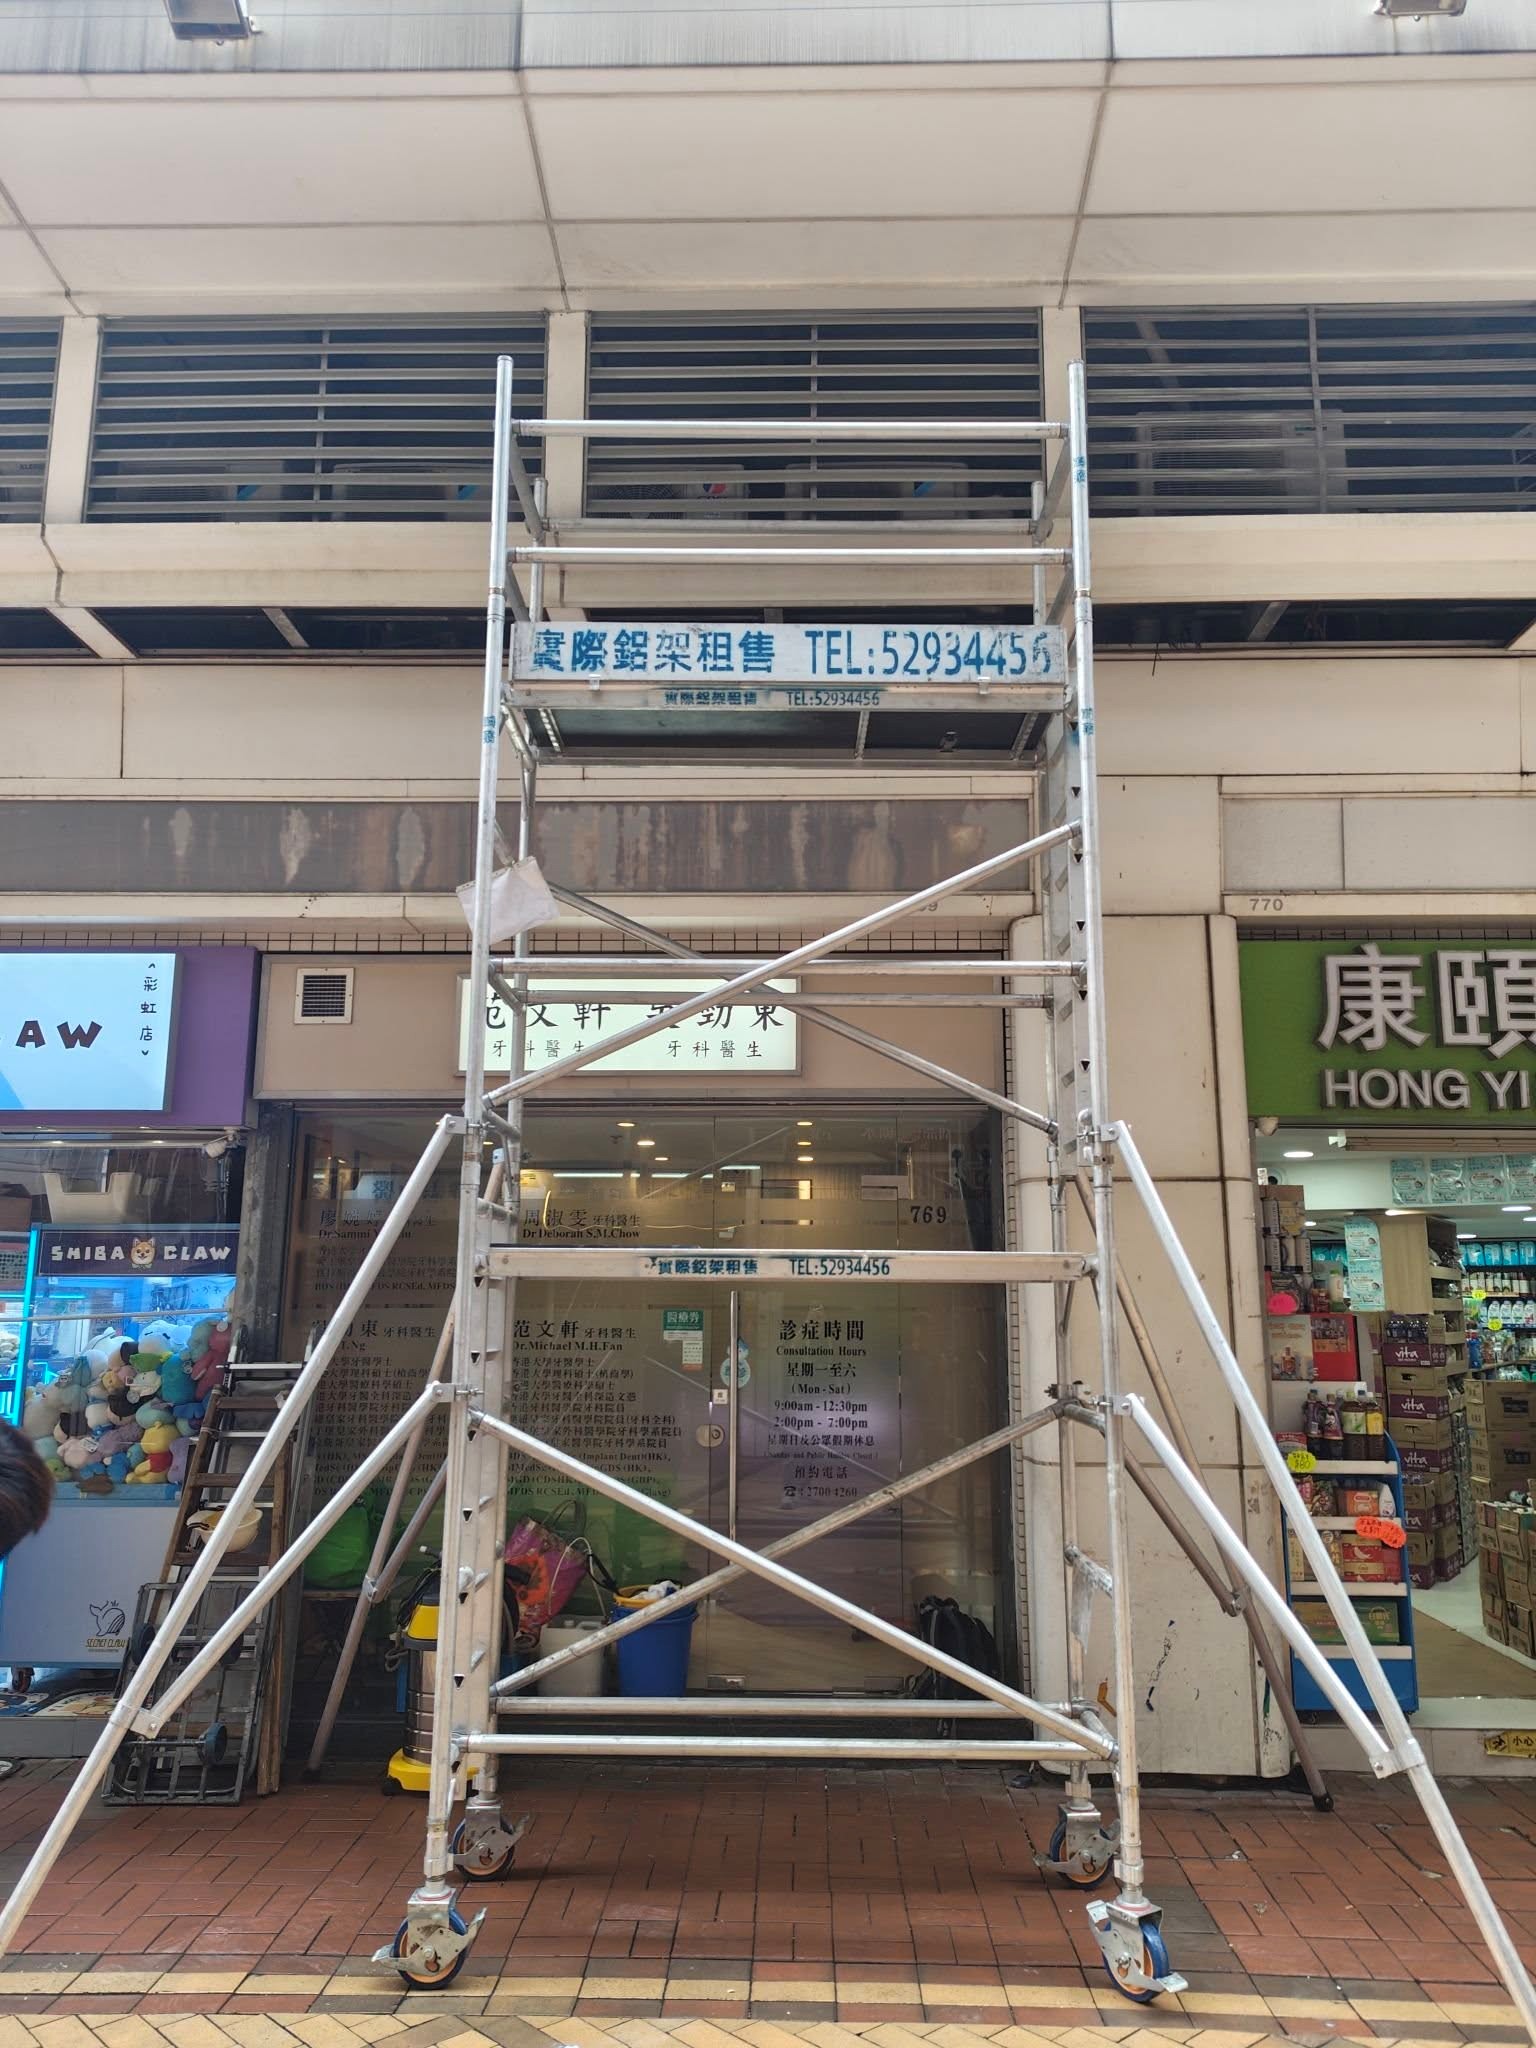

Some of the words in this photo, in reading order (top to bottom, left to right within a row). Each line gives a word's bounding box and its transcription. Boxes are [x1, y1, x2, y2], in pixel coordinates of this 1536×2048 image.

[804, 630, 1052, 676] TEL:52934456
[787, 690, 880, 706] TEL:52934456
[1249, 899, 1283, 912] 770
[140, 976, 158, 1041] 彩虹店
[667, 1040, 763, 1059] 牙科醫生
[1321, 1068, 1472, 1110] HONG
[1480, 1069, 1532, 1111] YI
[909, 1205, 947, 1224] 769
[523, 1229, 537, 1238] Dr
[539, 1228, 583, 1239] Deborah
[51, 1245, 125, 1261] SHIBA
[163, 1245, 232, 1261] CLAW
[789, 1258, 890, 1276] TEL:52934456
[584, 1327, 636, 1338] 牙科醫生
[780, 1320, 864, 1340] 診症時間
[776, 1345, 834, 1356] Consultation
[838, 1346, 867, 1356] Hours
[787, 1362, 856, 1377] 星期一至六
[774, 1400, 813, 1412] 9:00am
[823, 1400, 868, 1415] 12:30pm
[774, 1417, 814, 1430] 2:00pm
[828, 1417, 868, 1431] 7:00pm
